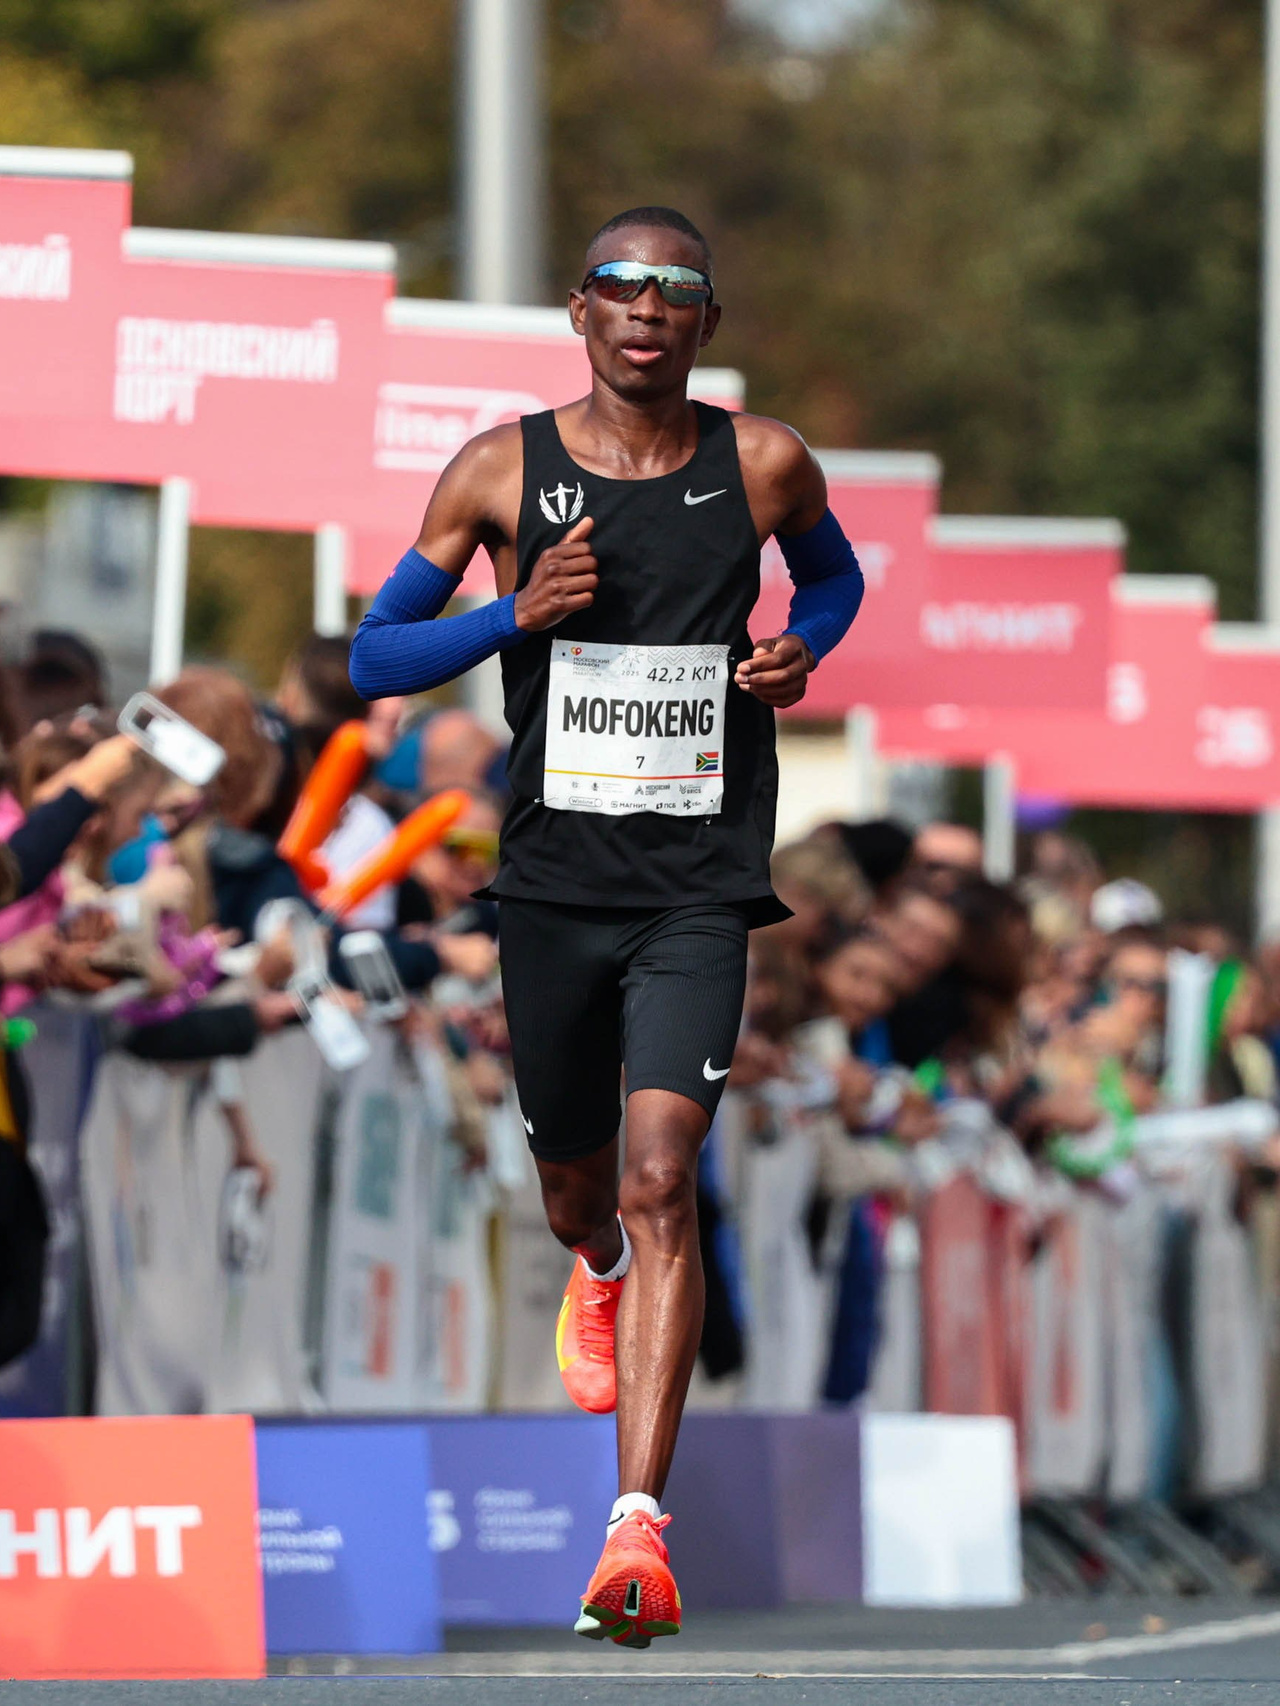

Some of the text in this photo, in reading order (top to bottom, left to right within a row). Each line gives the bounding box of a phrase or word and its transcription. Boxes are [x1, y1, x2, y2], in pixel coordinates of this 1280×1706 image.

[647, 666, 716, 684] 42,2 KM
[563, 695, 715, 738] MOFOKENG
[636, 756, 645, 769] 7
